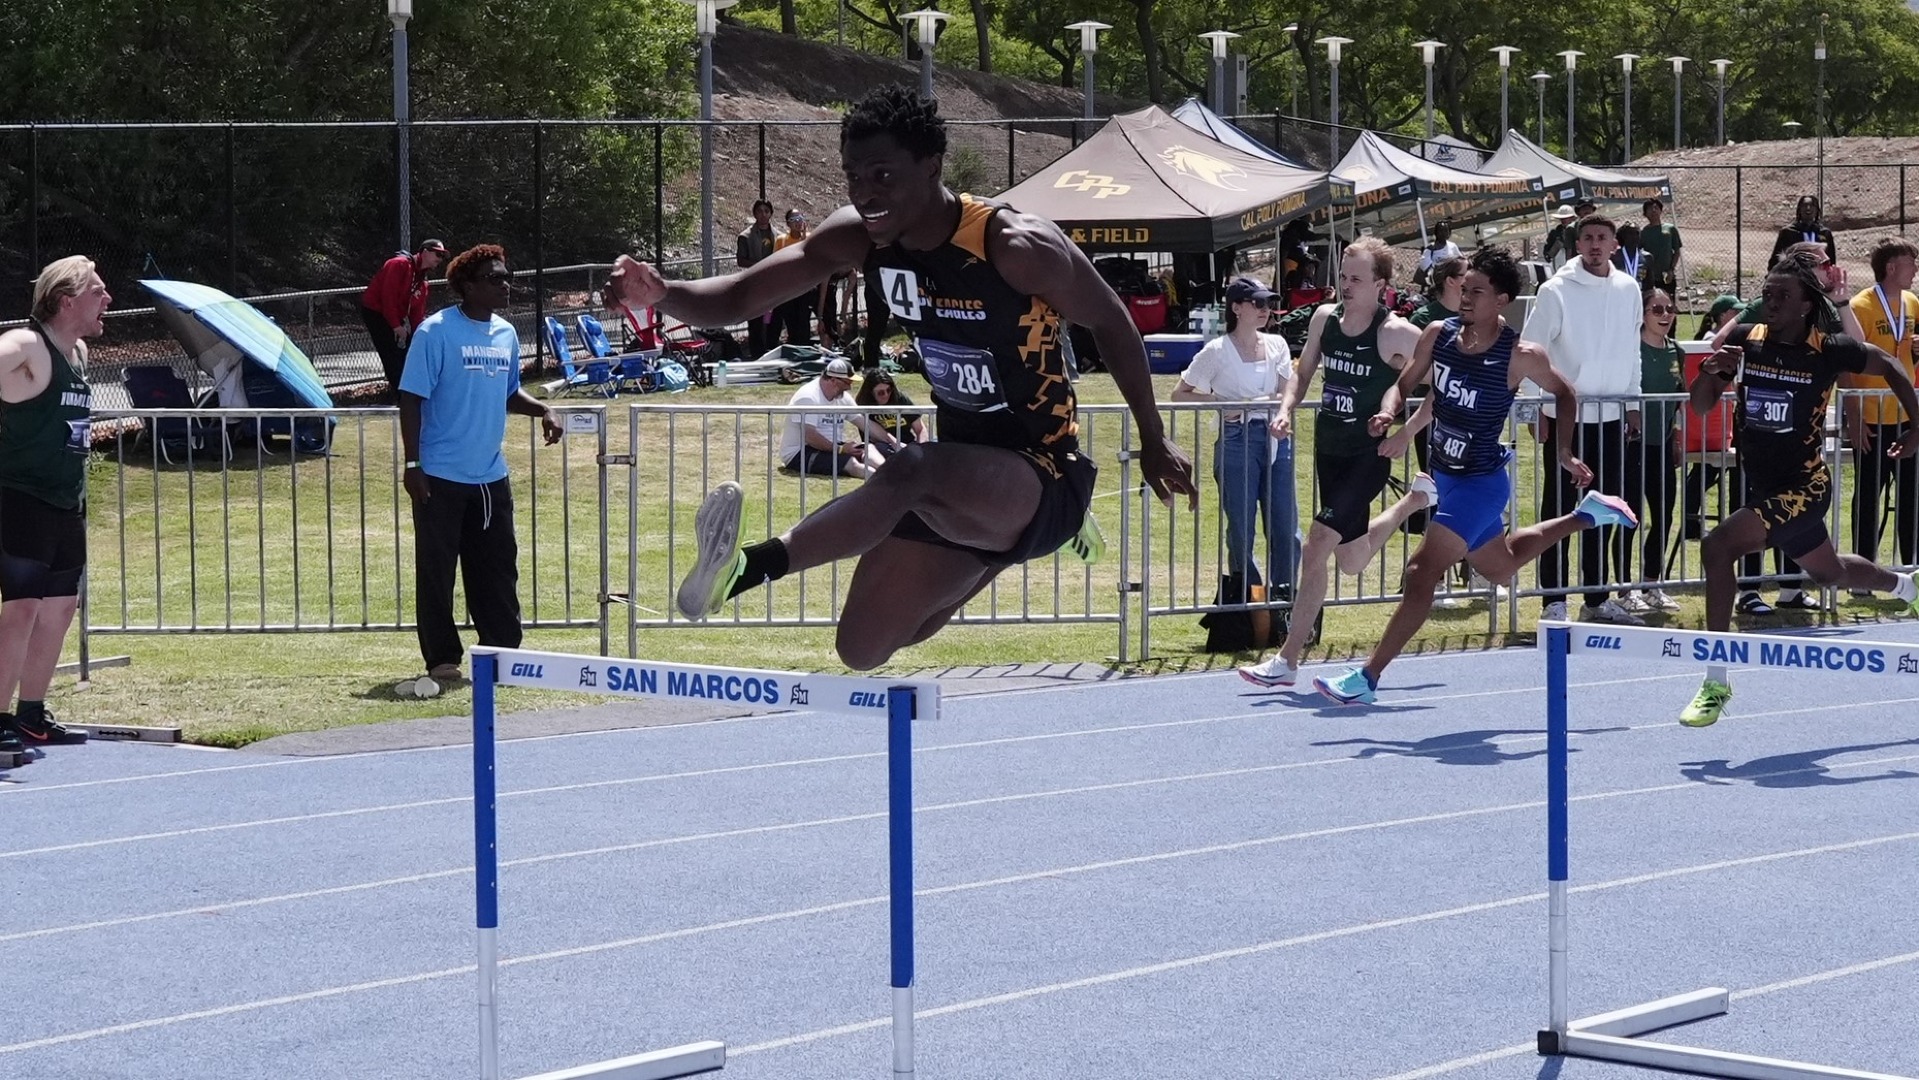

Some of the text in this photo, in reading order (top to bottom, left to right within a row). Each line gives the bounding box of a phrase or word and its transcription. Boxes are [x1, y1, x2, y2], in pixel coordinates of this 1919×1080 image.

[1053, 169, 1131, 199] CPP
[1431, 181, 1453, 194] CAL
[1484, 180, 1530, 194] POMONA
[1240, 211, 1257, 231] CAL
[1257, 202, 1276, 224] POLY
[1071, 228, 1149, 243] & FIELD
[890, 272, 914, 318] 4
[935, 298, 987, 320] EAGLES
[1324, 355, 1372, 377] UMBOLDT
[1435, 363, 1446, 387] 7
[1744, 362, 1813, 385] GOLDEN EAGLES
[952, 362, 996, 395] 284
[1335, 394, 1354, 413] 128
[1446, 379, 1478, 409] SM
[1763, 401, 1789, 422] 307
[1443, 437, 1467, 459] 487
[1585, 635, 1621, 650] GILL
[1693, 637, 1749, 664] SAN
[1760, 642, 1886, 674] MARCOS
[511, 662, 543, 679] GILL
[606, 665, 657, 694] SAN
[668, 671, 780, 705] MARCOS
[848, 691, 887, 708] GILL
